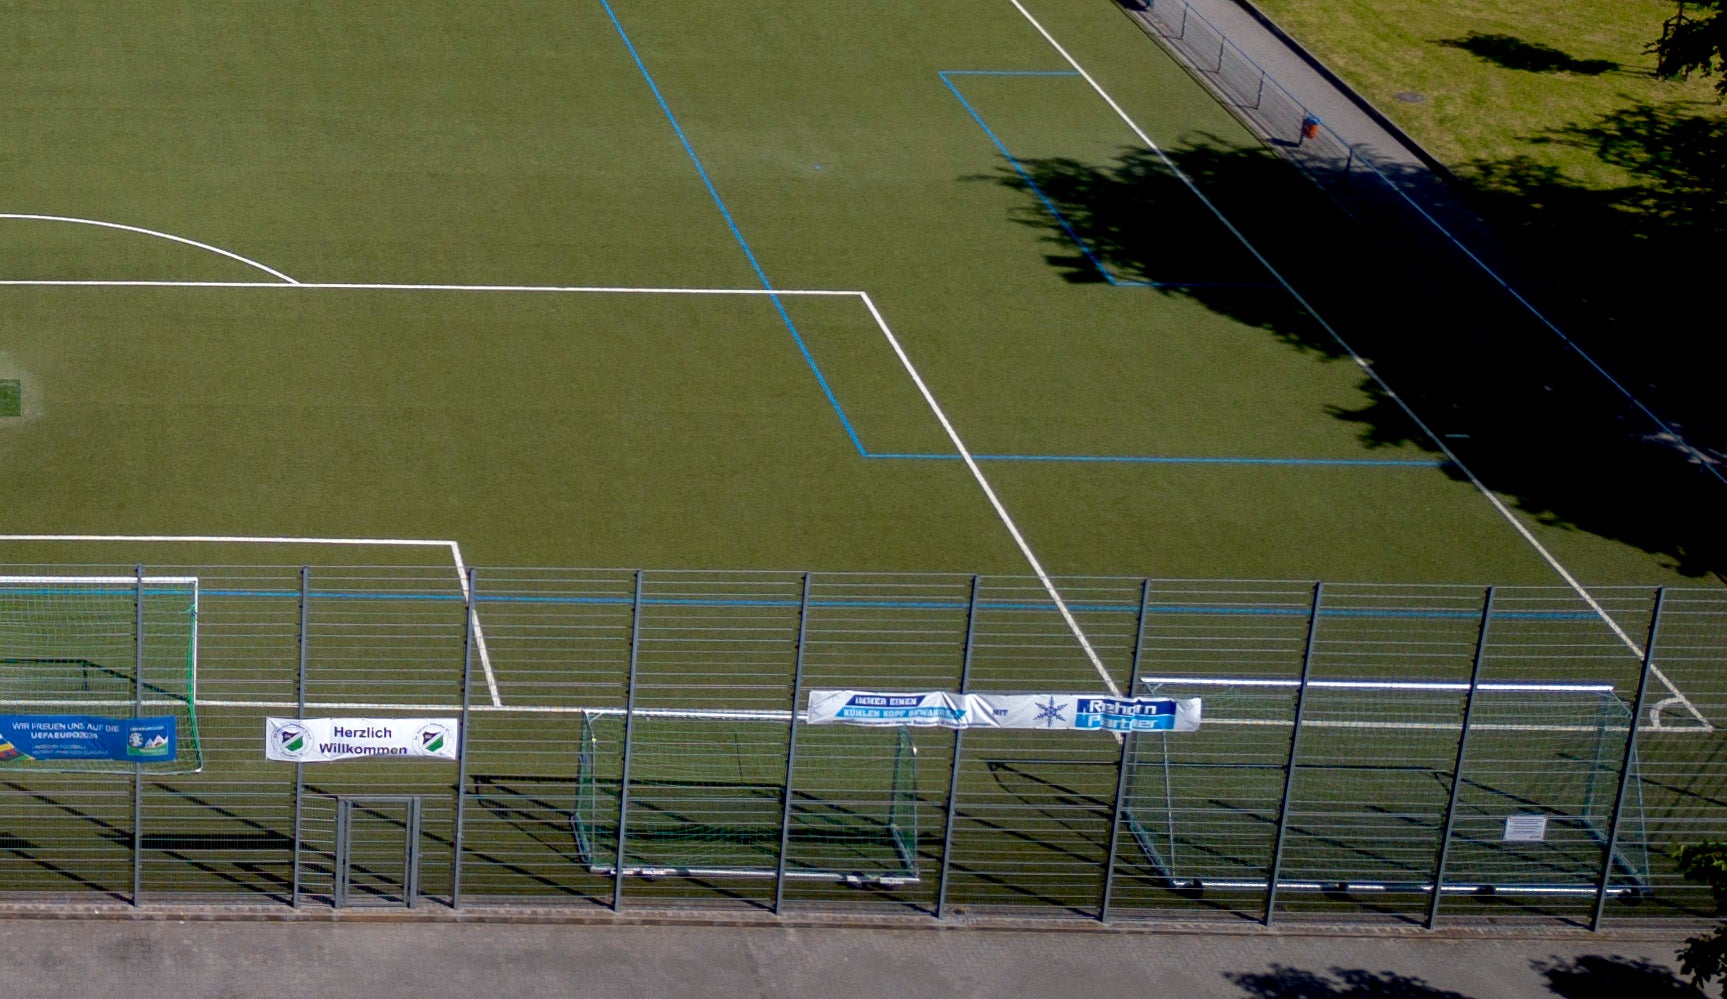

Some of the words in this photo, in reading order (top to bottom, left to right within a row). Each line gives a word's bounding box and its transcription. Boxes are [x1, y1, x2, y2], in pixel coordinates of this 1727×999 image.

[12, 722, 30, 731] WIR
[31, 722, 66, 731] FREUEN
[67, 722, 85, 731] UNS
[105, 725, 120, 733] DIE
[334, 726, 392, 739] Herzlich
[319, 742, 408, 755] Willkommen
